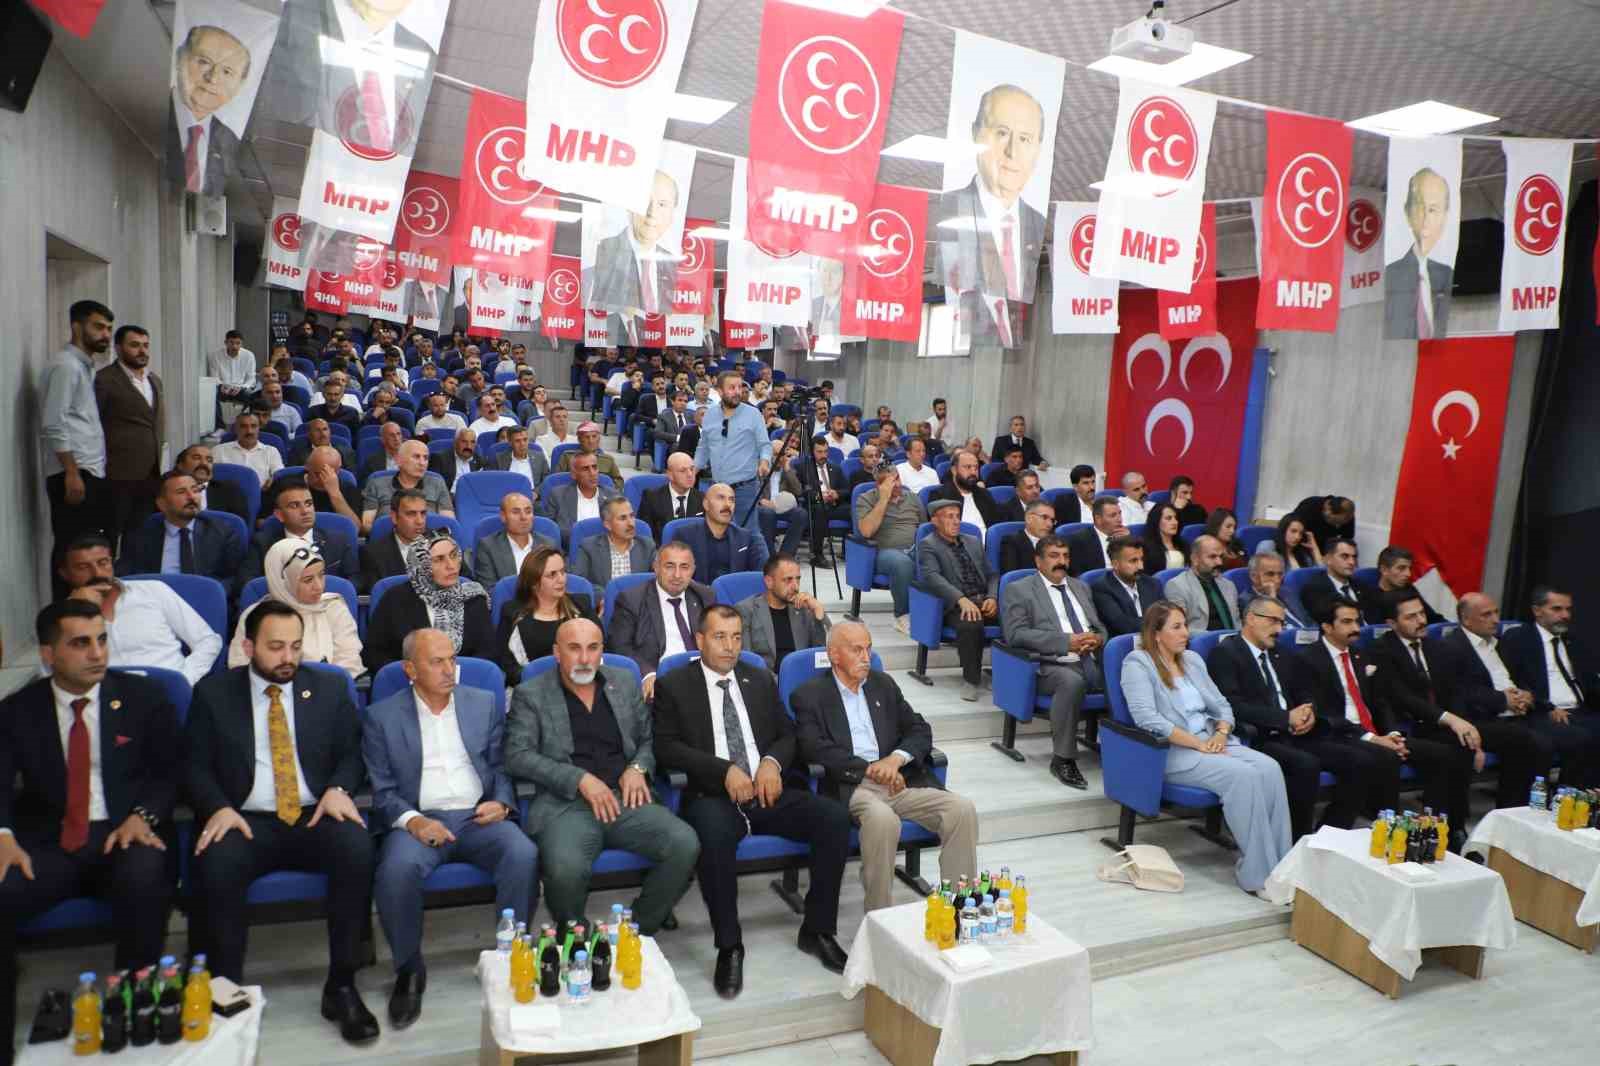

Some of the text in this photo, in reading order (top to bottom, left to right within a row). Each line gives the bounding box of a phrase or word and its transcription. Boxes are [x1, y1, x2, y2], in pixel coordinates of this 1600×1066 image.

[546, 124, 637, 167] MHP
[768, 187, 859, 232] MHP
[470, 226, 532, 256] MHP
[1120, 228, 1181, 264] MHP
[268, 260, 301, 279] MHP
[344, 281, 374, 296] MHP
[748, 282, 802, 304] MHP
[1277, 279, 1333, 309] MHP
[1512, 286, 1557, 311] MHP
[476, 305, 506, 319] MHP
[856, 299, 904, 322] MHP
[1072, 298, 1113, 316] MHP
[1168, 305, 1203, 325] MHP
[547, 317, 575, 329] MHP
[669, 326, 696, 337] MHP
